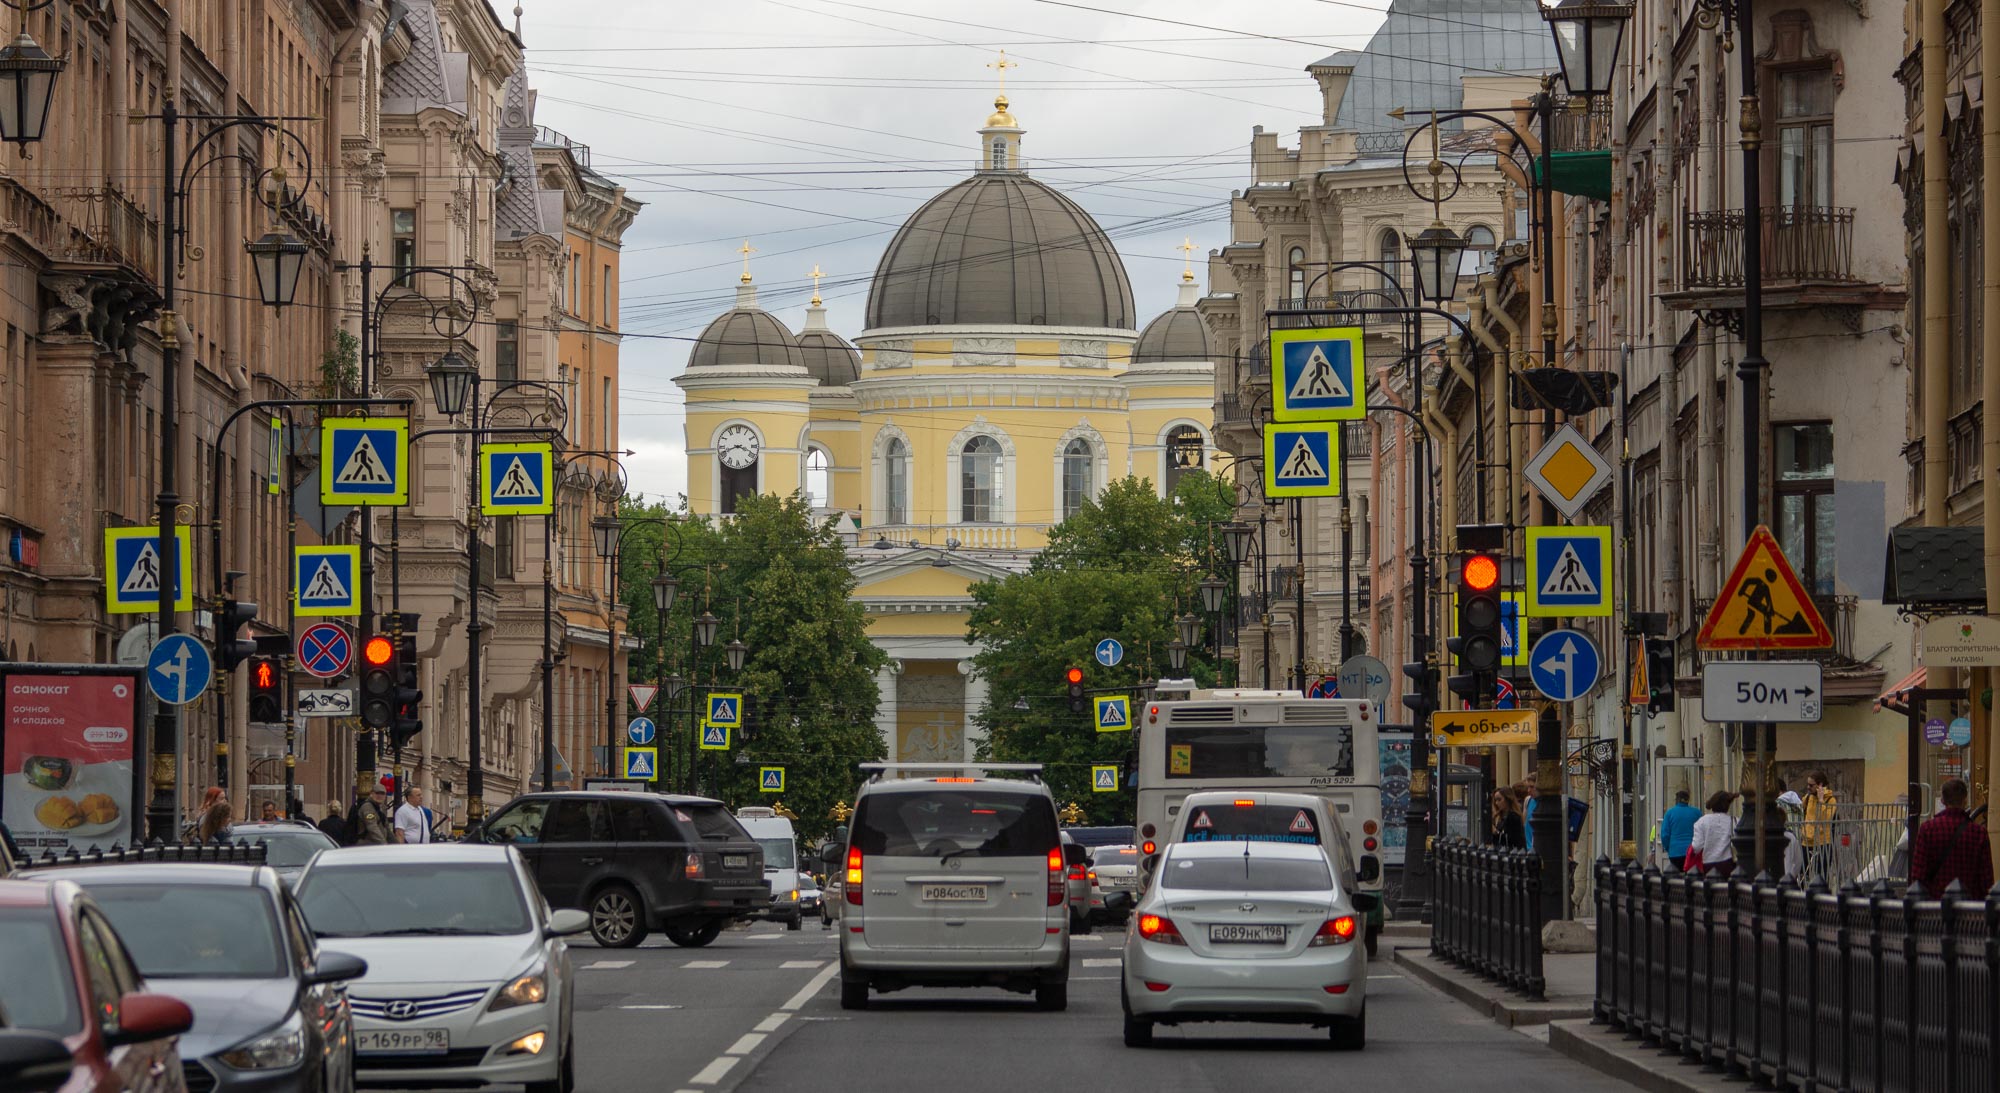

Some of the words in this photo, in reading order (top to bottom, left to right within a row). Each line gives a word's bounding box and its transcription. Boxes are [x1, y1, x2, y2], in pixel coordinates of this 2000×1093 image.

[13, 685, 70, 695] самокат
[22, 718, 65, 726] сладкое
[1469, 719, 1532, 734] объезд
[1334, 777, 1356, 785] 5292
[1235, 834, 1317, 843] стоматологии
